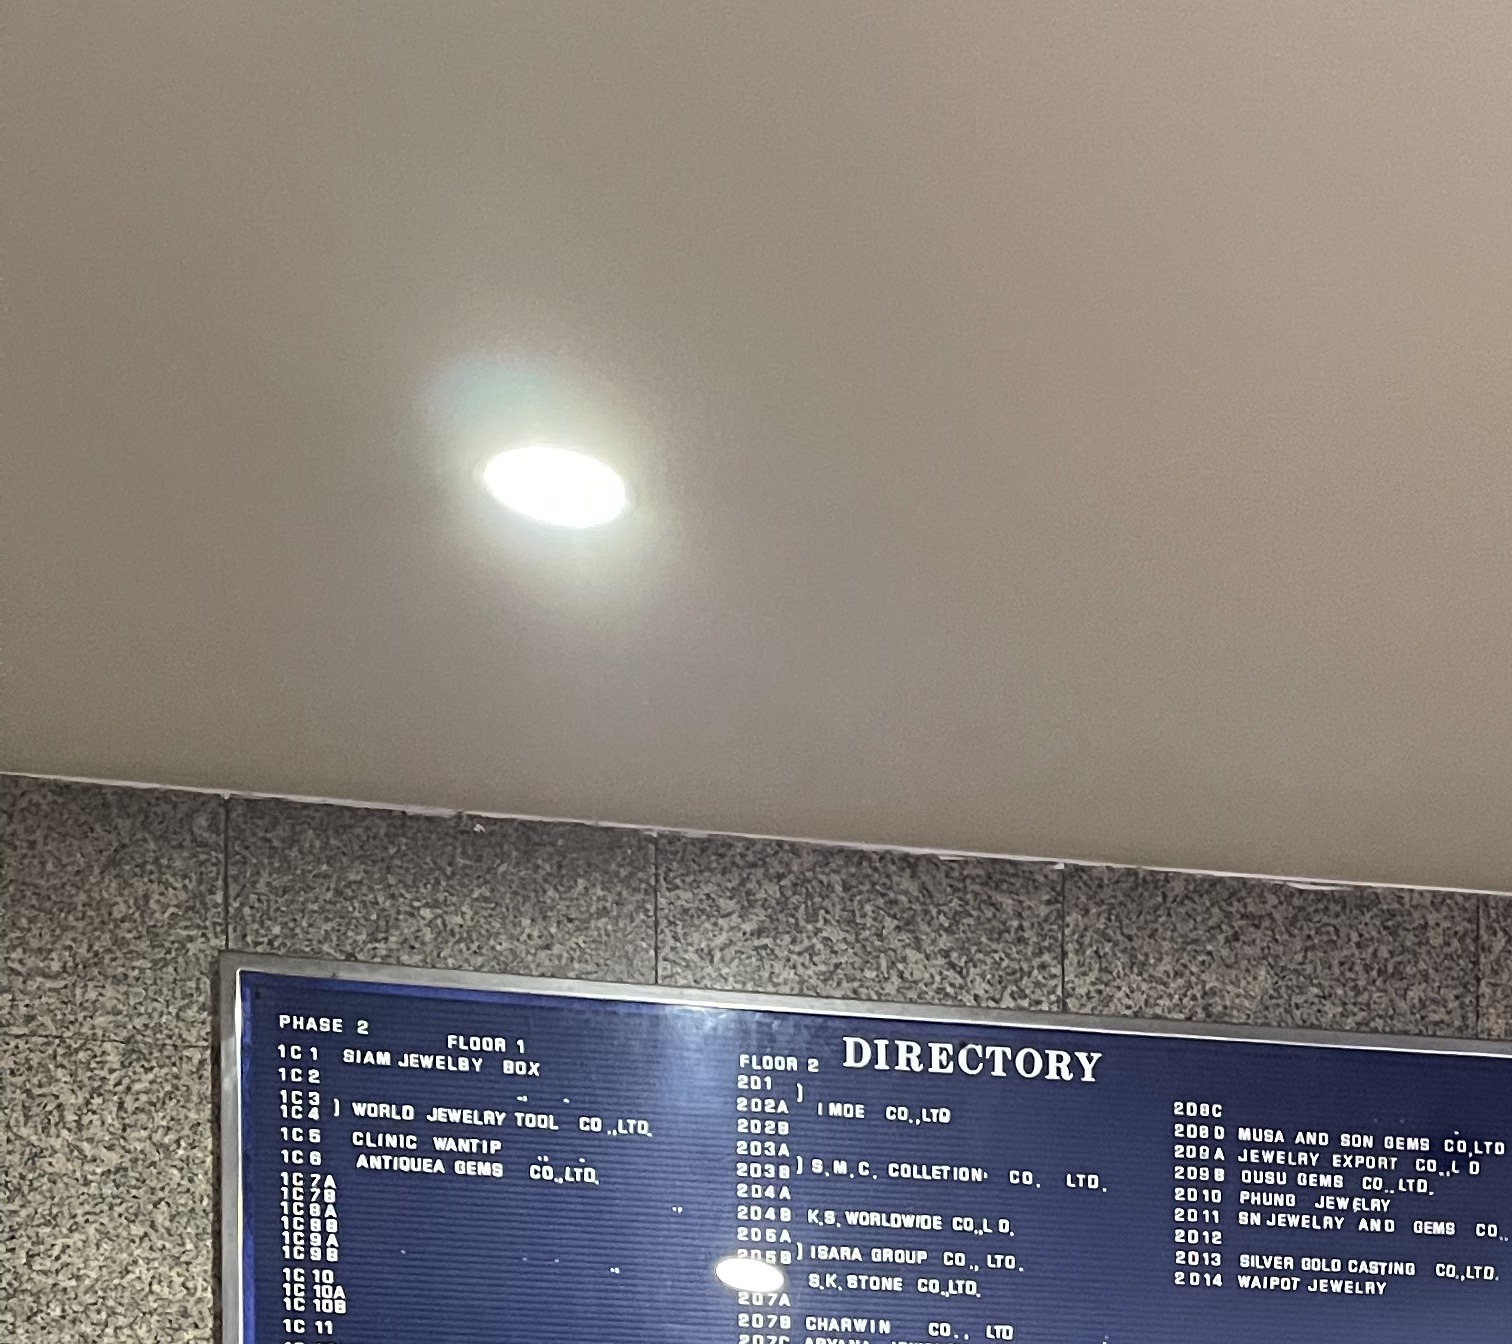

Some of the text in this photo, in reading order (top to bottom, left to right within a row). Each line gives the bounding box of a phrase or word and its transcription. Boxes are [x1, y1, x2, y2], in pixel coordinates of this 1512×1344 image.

[279, 1015, 369, 1035] PHASE 2
[447, 1035, 524, 1053] FLOOR 1
[343, 1049, 391, 1066] SIAM
[503, 1060, 540, 1076] BOX
[740, 1054, 819, 1072] FLOOR 2
[842, 1037, 1102, 1082] DIRECTORY
[738, 1075, 771, 1090] 201
[737, 1097, 789, 1114] 202A
[829, 1102, 864, 1118] MOE
[352, 1102, 559, 1130] WORLD JEWELRY TOOL
[352, 1131, 501, 1154] CLINIC WANTIP
[737, 1141, 790, 1157] 203A
[1238, 1127, 1429, 1151] MUSA AND SON GEMS
[356, 1154, 503, 1178] ANTIQUEA GEMS
[1238, 1149, 1398, 1170] JEWELRY EXPORT
[1297, 1172, 1343, 1188] GEMS
[737, 1183, 791, 1200] 204A
[1175, 1187, 1390, 1213] 2010 PHUNG JEWELRY
[845, 1211, 942, 1230] WORLDWIDE
[1174, 1208, 1455, 1235] 2011 SN JEWELRY AND GEMS
[1175, 1229, 1222, 1244] 2012
[811, 1245, 862, 1261] ISARA
[871, 1248, 927, 1264] GROUP
[1176, 1251, 1221, 1266] 2013
[1240, 1254, 1294, 1270] SILVER
[1301, 1257, 1341, 1272] GOLD
[1348, 1260, 1415, 1276] CASTING
[1174, 1271, 1386, 1295] 2014 WAIPOT JEWELRY
[738, 1313, 1013, 1340] 207B CHARWIN LTD
